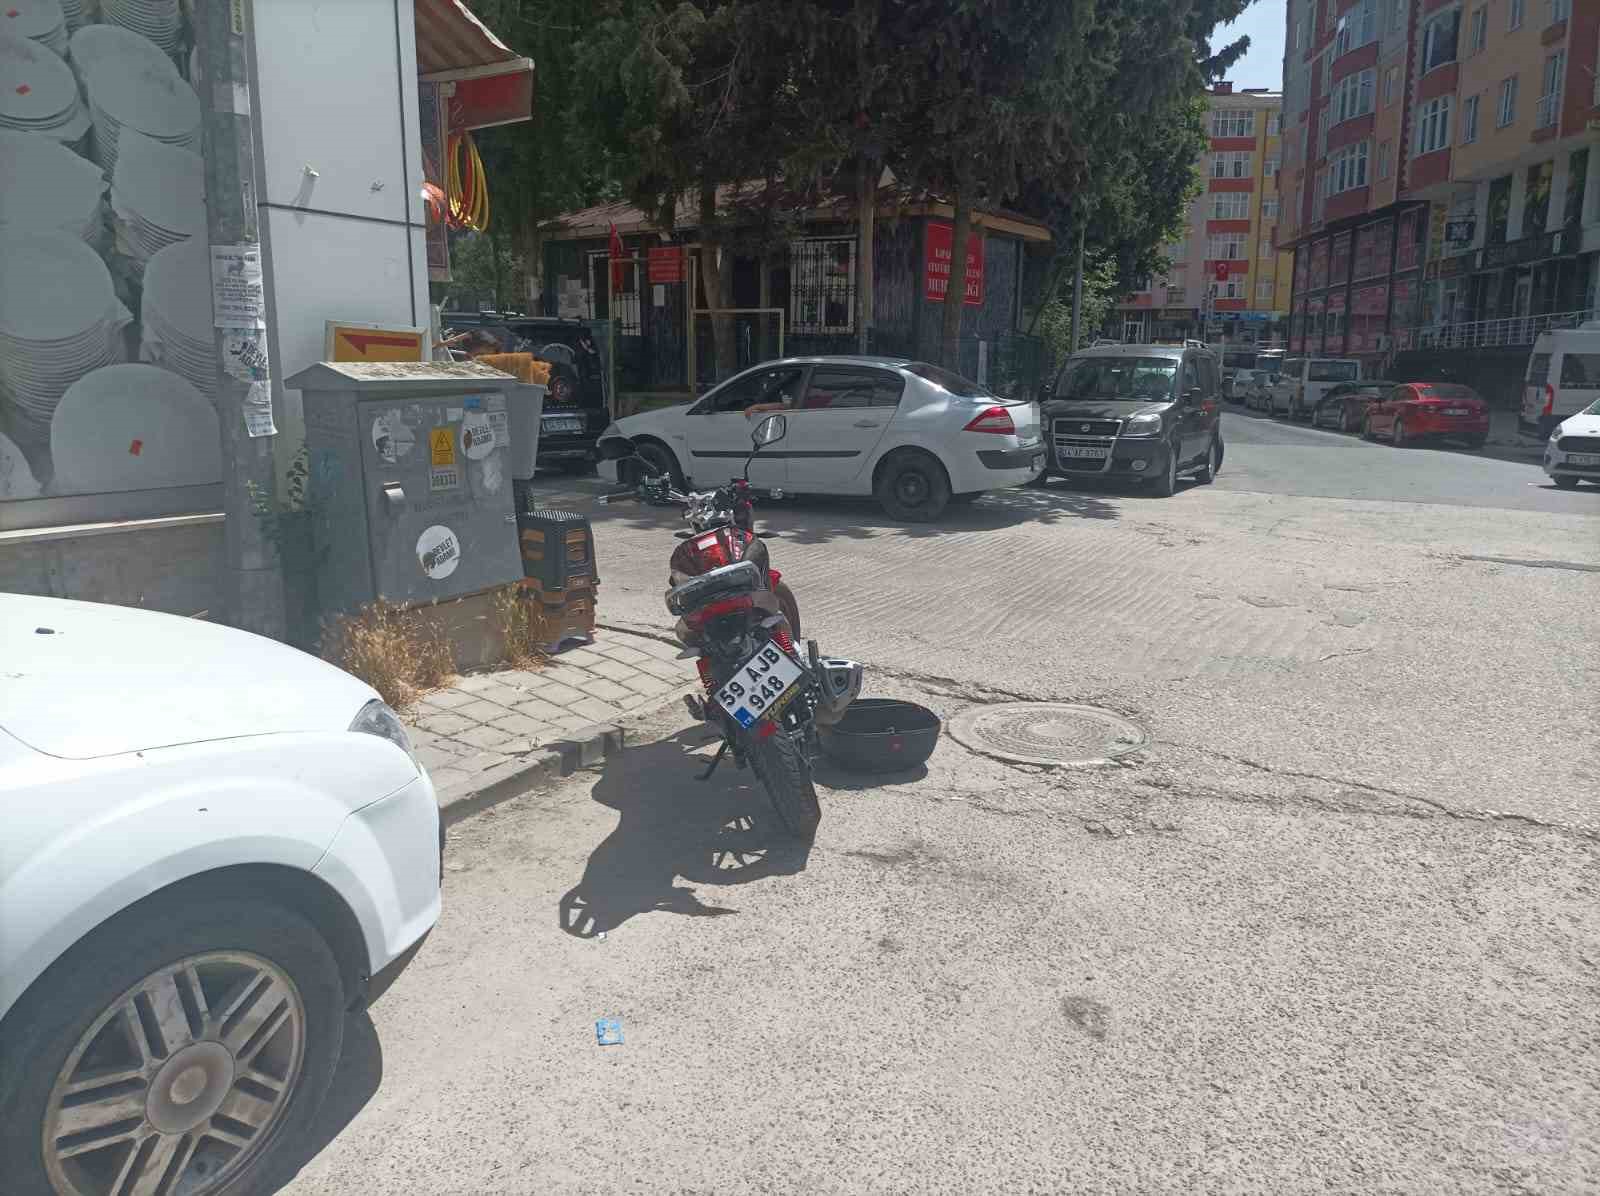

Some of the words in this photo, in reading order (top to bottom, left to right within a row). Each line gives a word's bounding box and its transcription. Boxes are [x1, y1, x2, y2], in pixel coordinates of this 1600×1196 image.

[719, 681, 745, 706] 59
[746, 647, 780, 682] AJB
[749, 676, 784, 709] 948
